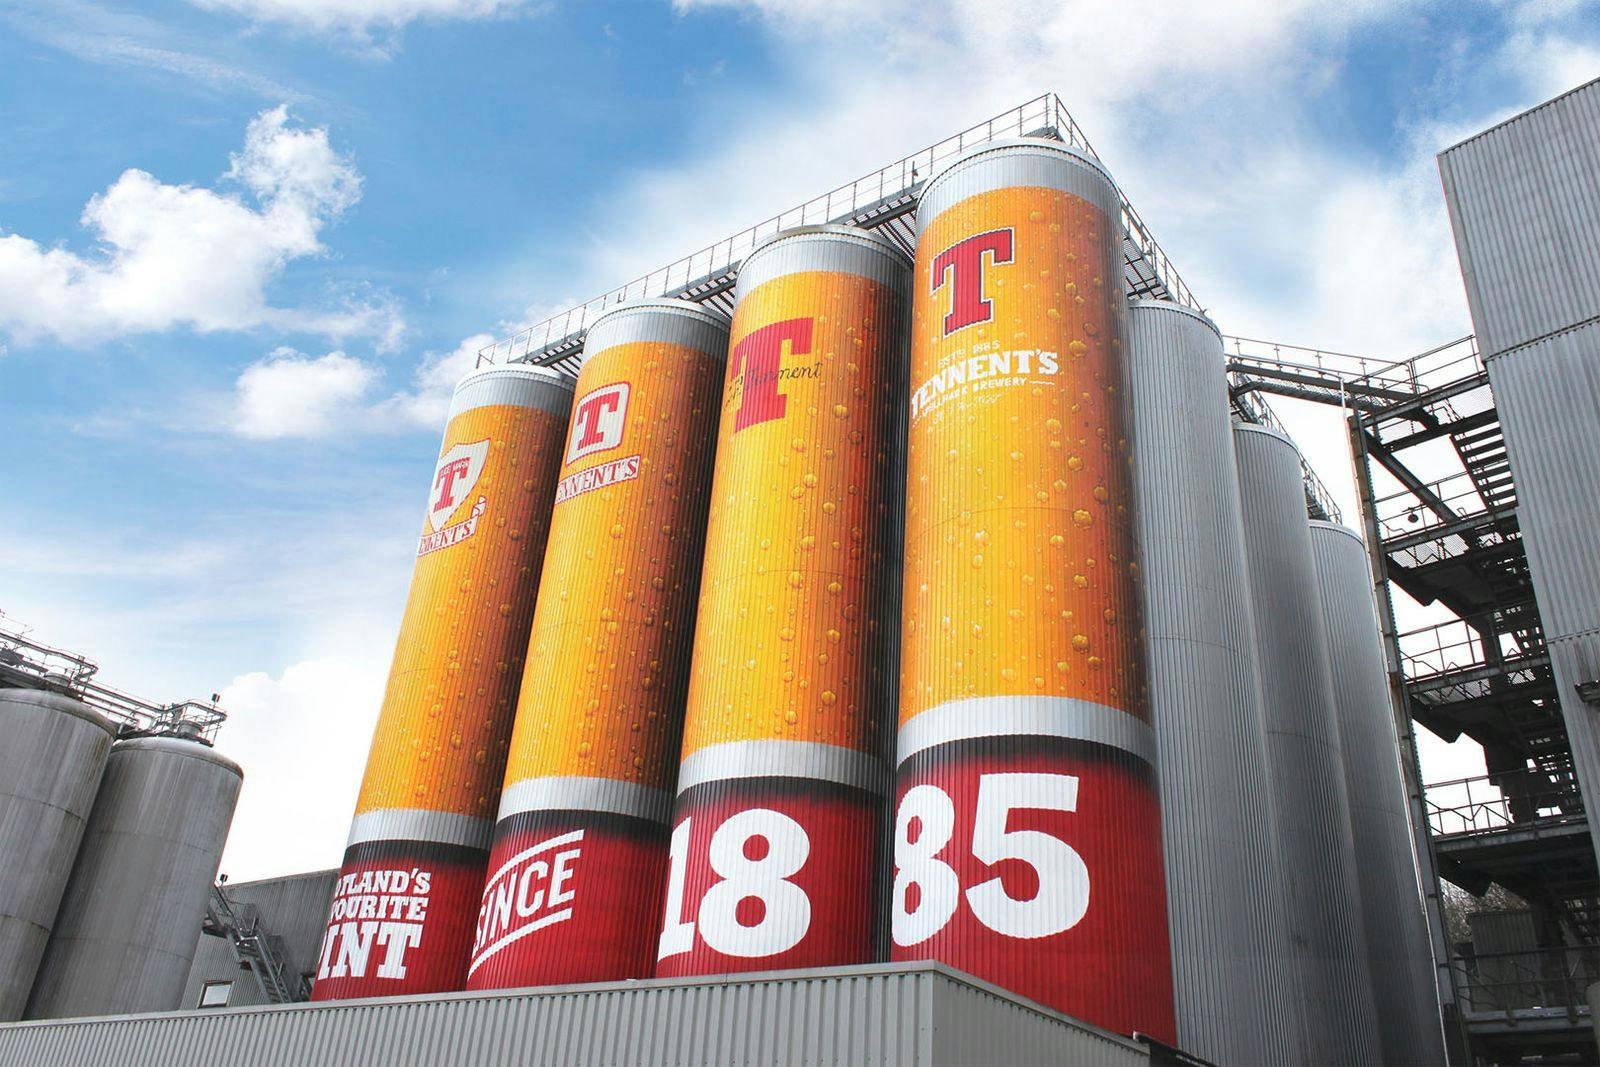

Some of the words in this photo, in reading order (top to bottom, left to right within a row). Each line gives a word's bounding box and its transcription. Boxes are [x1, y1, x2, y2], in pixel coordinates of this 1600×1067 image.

[929, 226, 1015, 340] T
[577, 391, 620, 451] T
[731, 316, 814, 434] T
[973, 377, 1027, 393] BREWERY
[434, 457, 472, 513] T
[472, 848, 581, 959] SINCE
[657, 808, 812, 963] 18
[891, 772, 1091, 948] 85
[318, 921, 423, 981] INT
